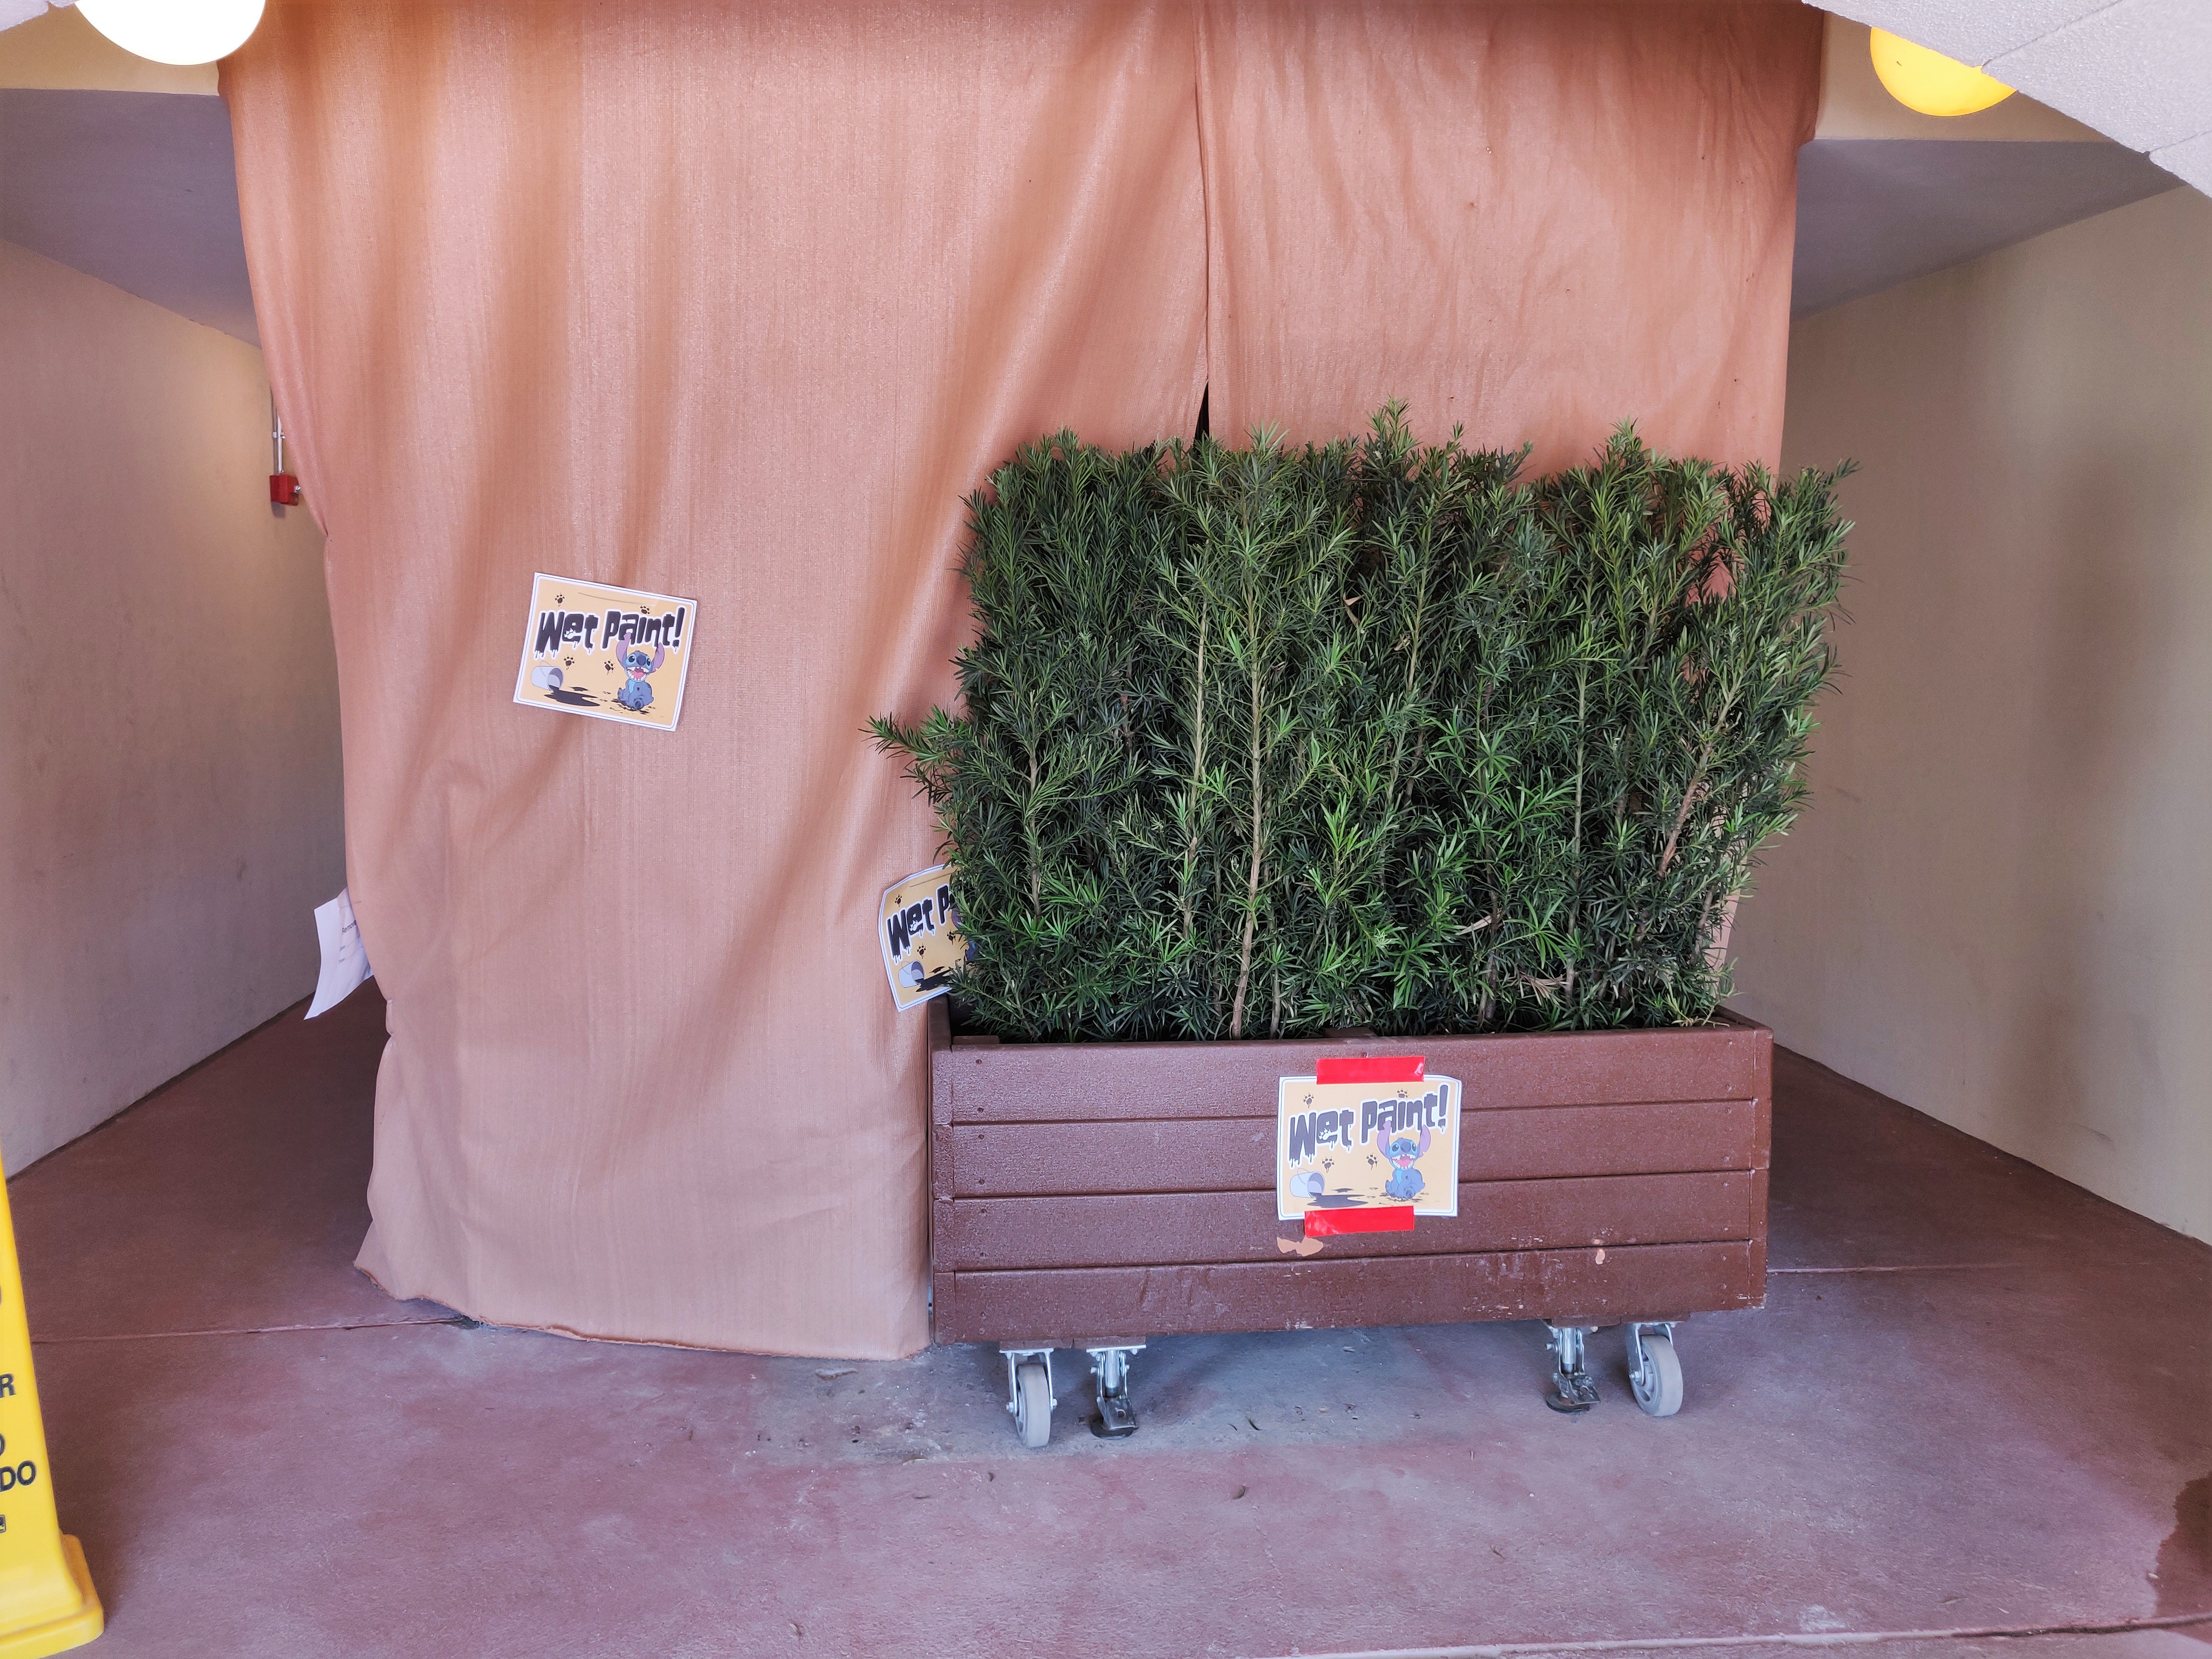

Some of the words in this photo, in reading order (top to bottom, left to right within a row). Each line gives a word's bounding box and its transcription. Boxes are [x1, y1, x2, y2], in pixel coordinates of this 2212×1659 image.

[534, 612, 599, 659] Wet
[887, 899, 934, 964] Wet
[938, 885, 956, 924] P
[1289, 1110, 1354, 1167] Wet
